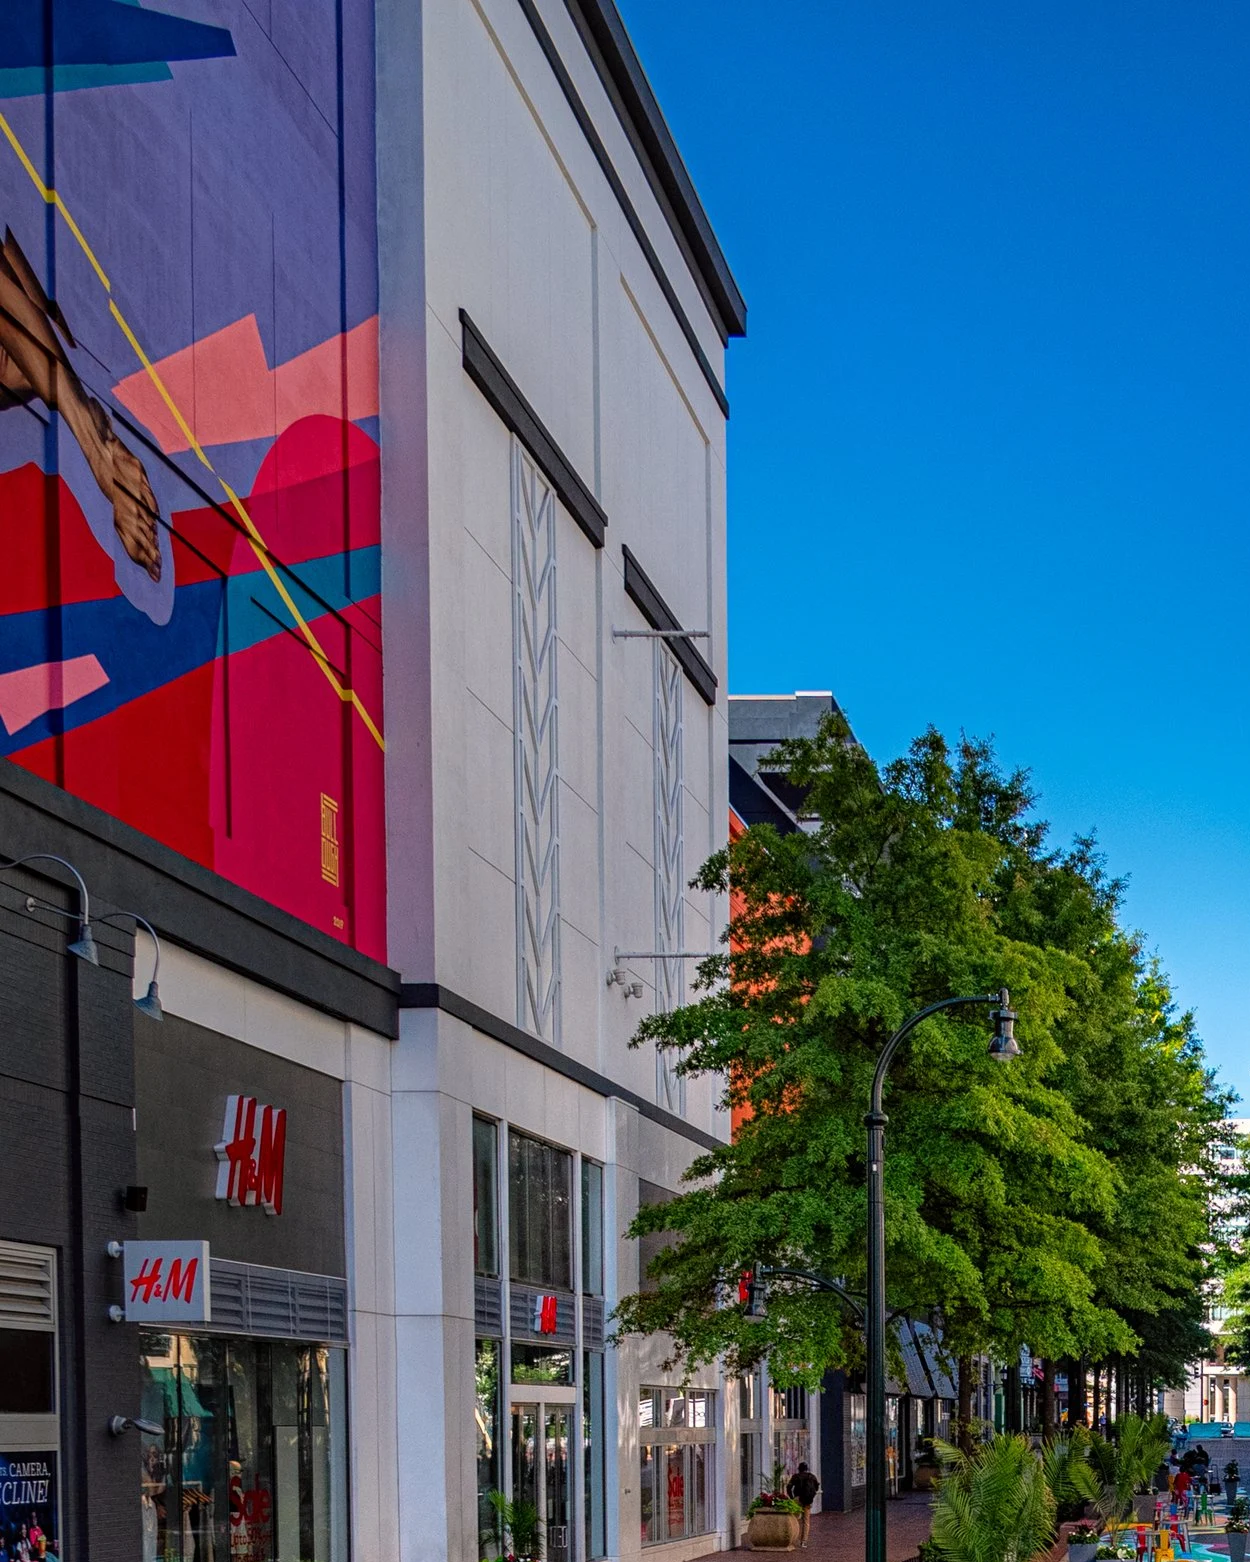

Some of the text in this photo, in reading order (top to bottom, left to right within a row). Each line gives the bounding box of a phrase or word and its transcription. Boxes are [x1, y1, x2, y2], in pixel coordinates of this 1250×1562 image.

[222, 1094, 288, 1216] H&M
[130, 1257, 199, 1304] H&M
[9, 1462, 51, 1477] CAMERA,
[0, 1480, 49, 1505] CLINE!
